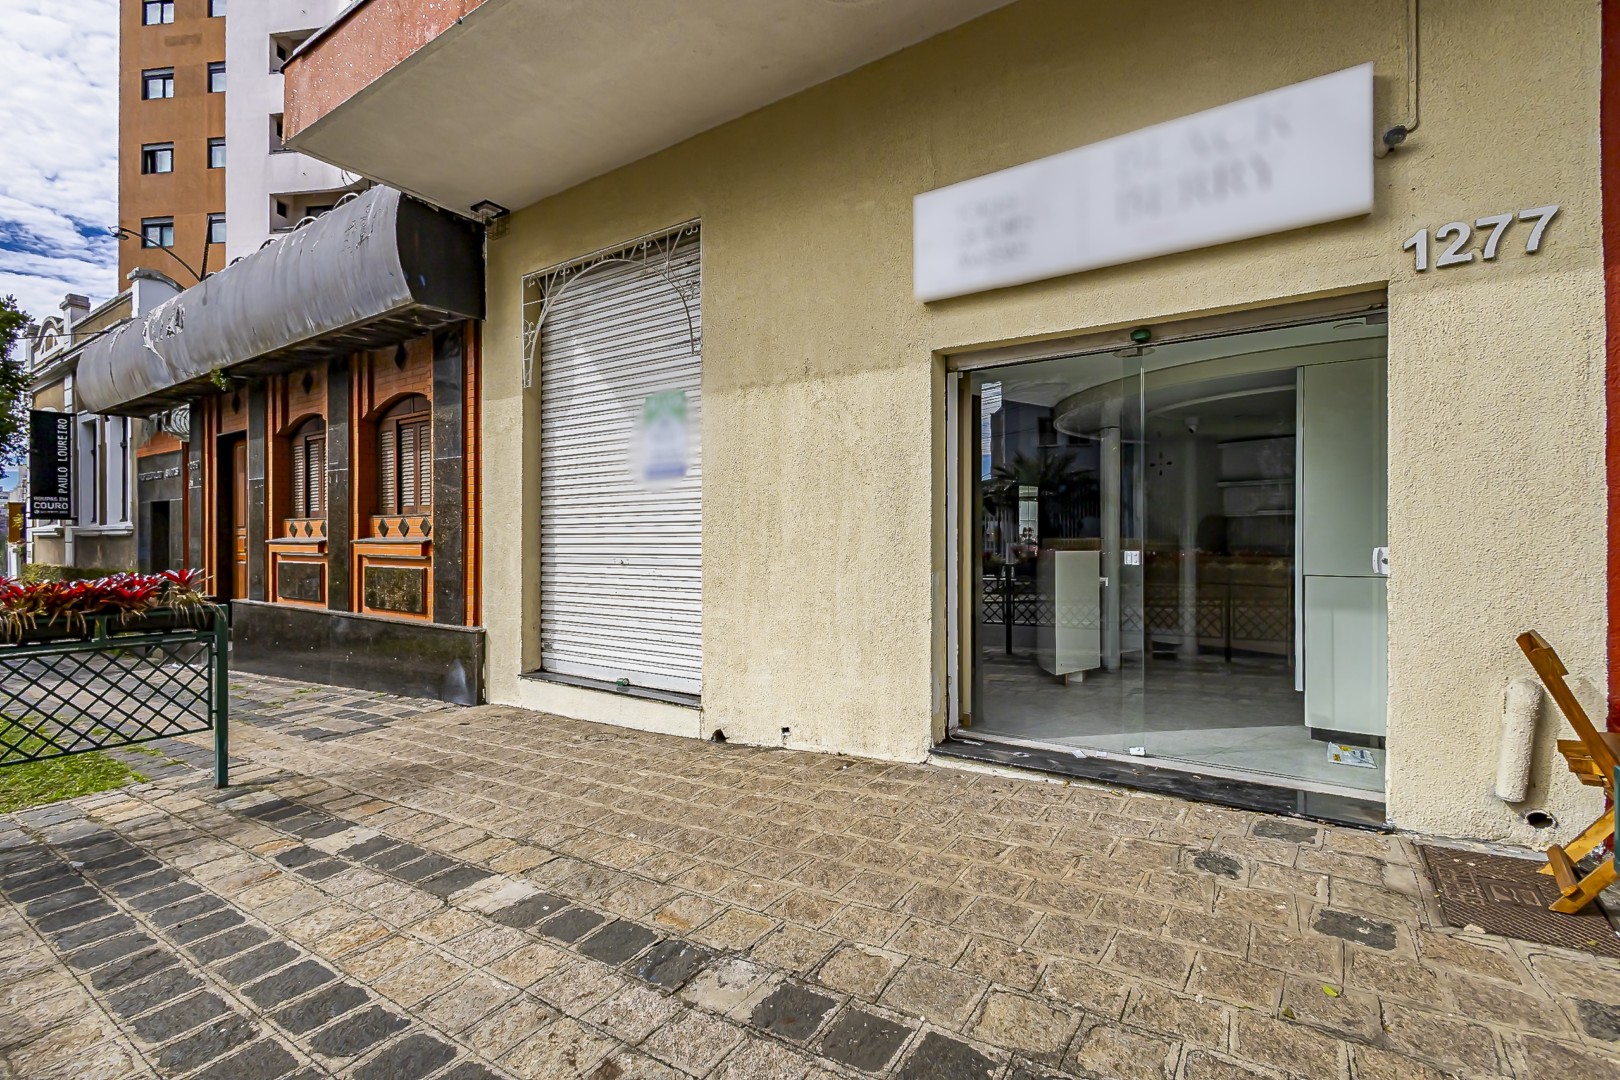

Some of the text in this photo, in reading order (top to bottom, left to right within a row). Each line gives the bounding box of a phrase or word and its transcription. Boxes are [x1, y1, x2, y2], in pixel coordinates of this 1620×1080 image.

[1403, 205, 1561, 272] 1277
[57, 418, 68, 494] PAULO LOUREIRO
